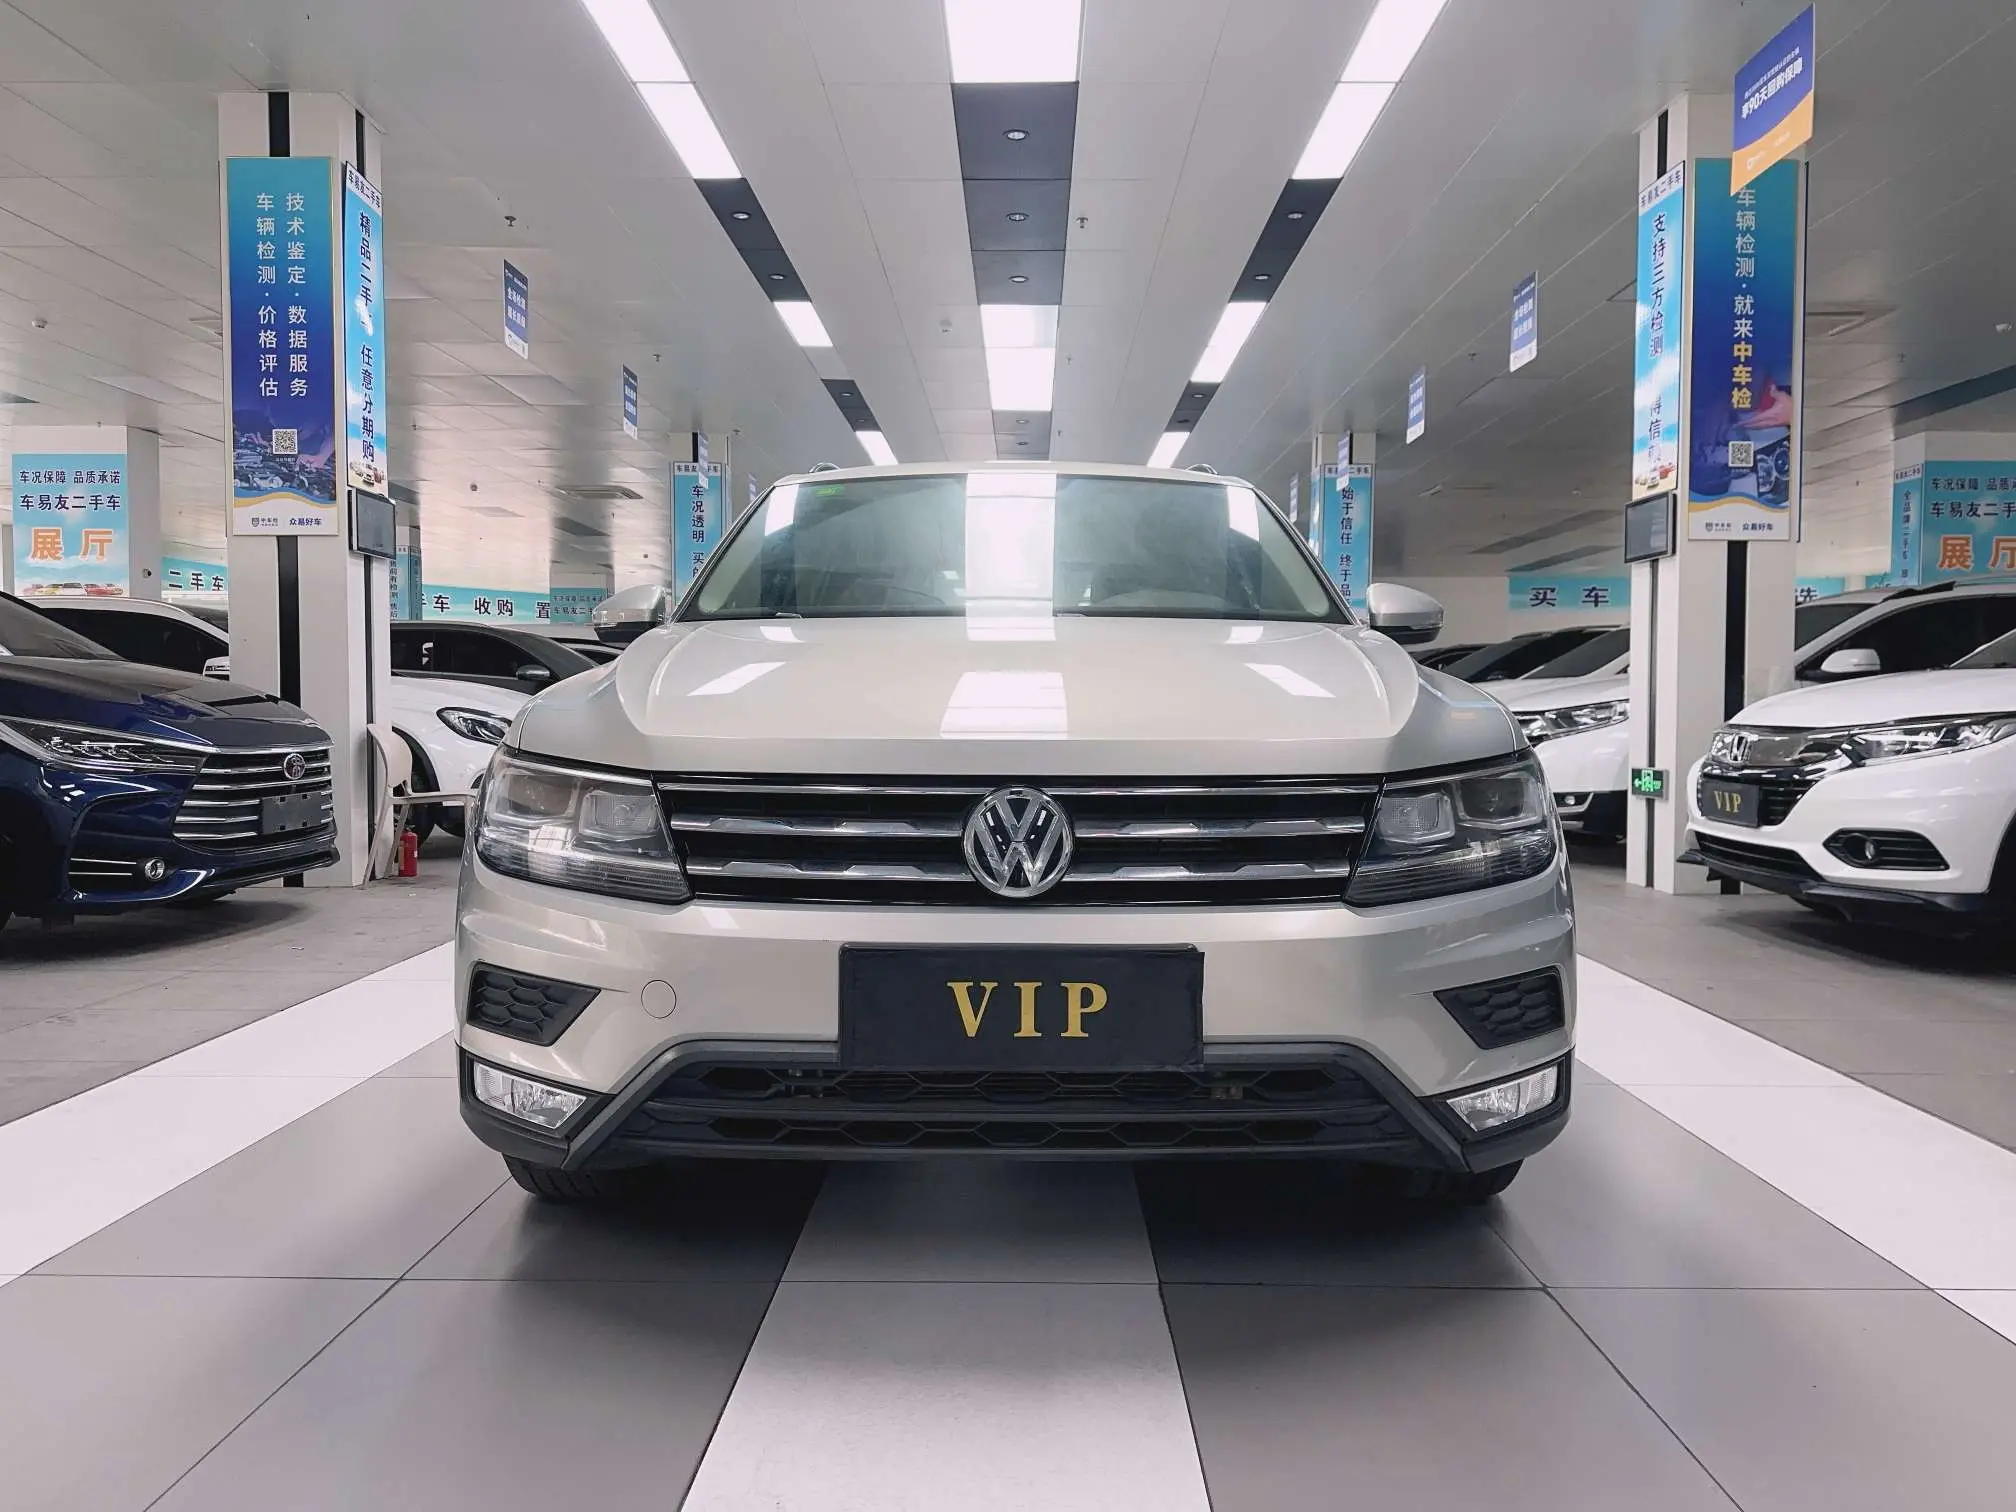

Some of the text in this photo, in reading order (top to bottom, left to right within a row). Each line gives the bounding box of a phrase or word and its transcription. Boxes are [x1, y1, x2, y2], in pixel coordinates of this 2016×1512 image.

[1649, 213, 1667, 357] 支持三方检测
[360, 344, 375, 463] 任意分期购
[19, 469, 121, 485] 车况保障 品质承诺
[20, 494, 121, 511] 车易友二手车
[691, 485, 705, 543] 车况透明
[1340, 486, 1354, 545] 始于信任
[30, 527, 113, 562] 展厅
[168, 569, 225, 591] 二手车
[474, 597, 513, 617] 收购
[1529, 585, 1609, 608] 买车
[1713, 790, 1741, 814] VIP
[946, 981, 1108, 1038] VIP
